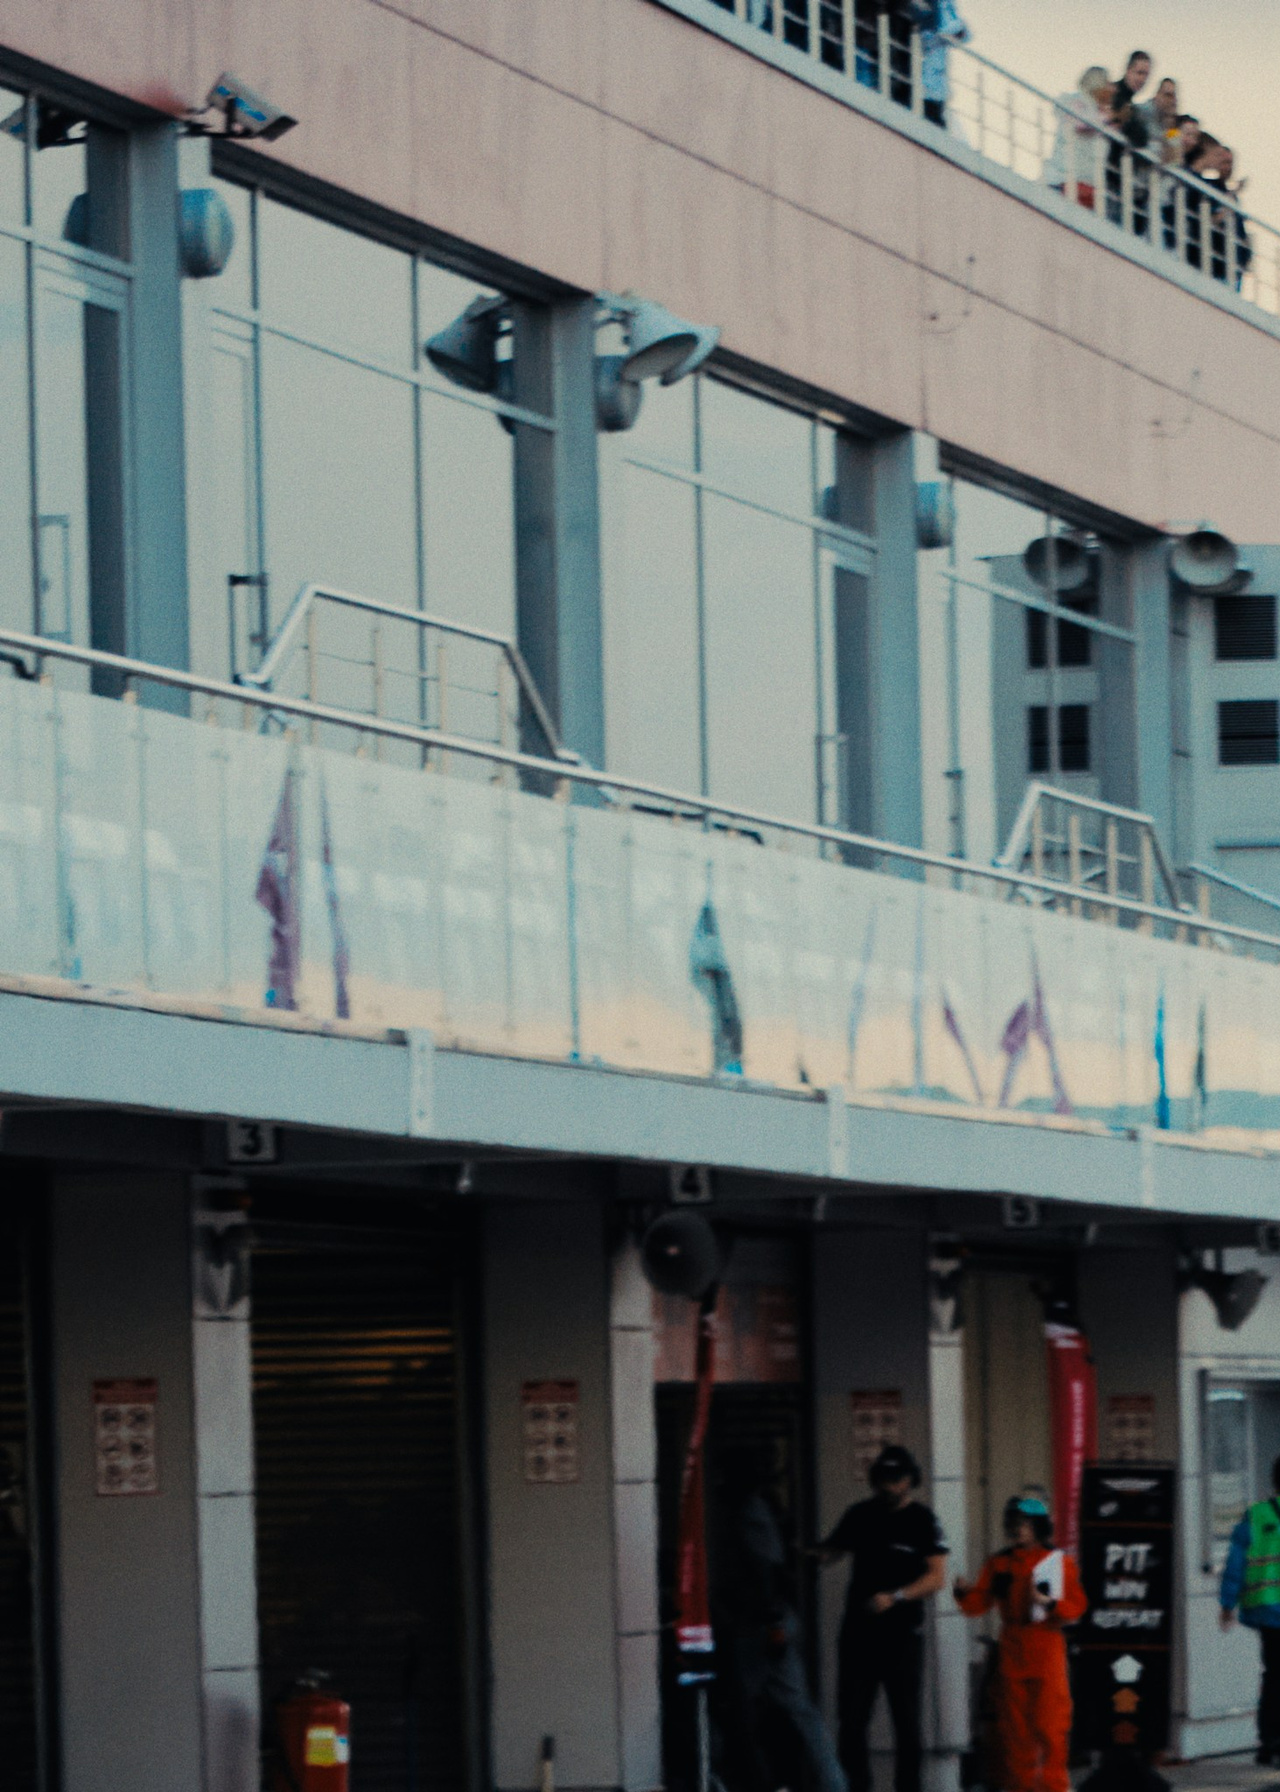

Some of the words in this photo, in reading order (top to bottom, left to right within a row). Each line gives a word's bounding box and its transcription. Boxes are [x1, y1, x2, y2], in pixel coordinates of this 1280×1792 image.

[238, 1122, 264, 1156] 3
[680, 1166, 703, 1198] 4
[1011, 1197, 1032, 1224] 5
[1103, 1542, 1154, 1575] PIT
